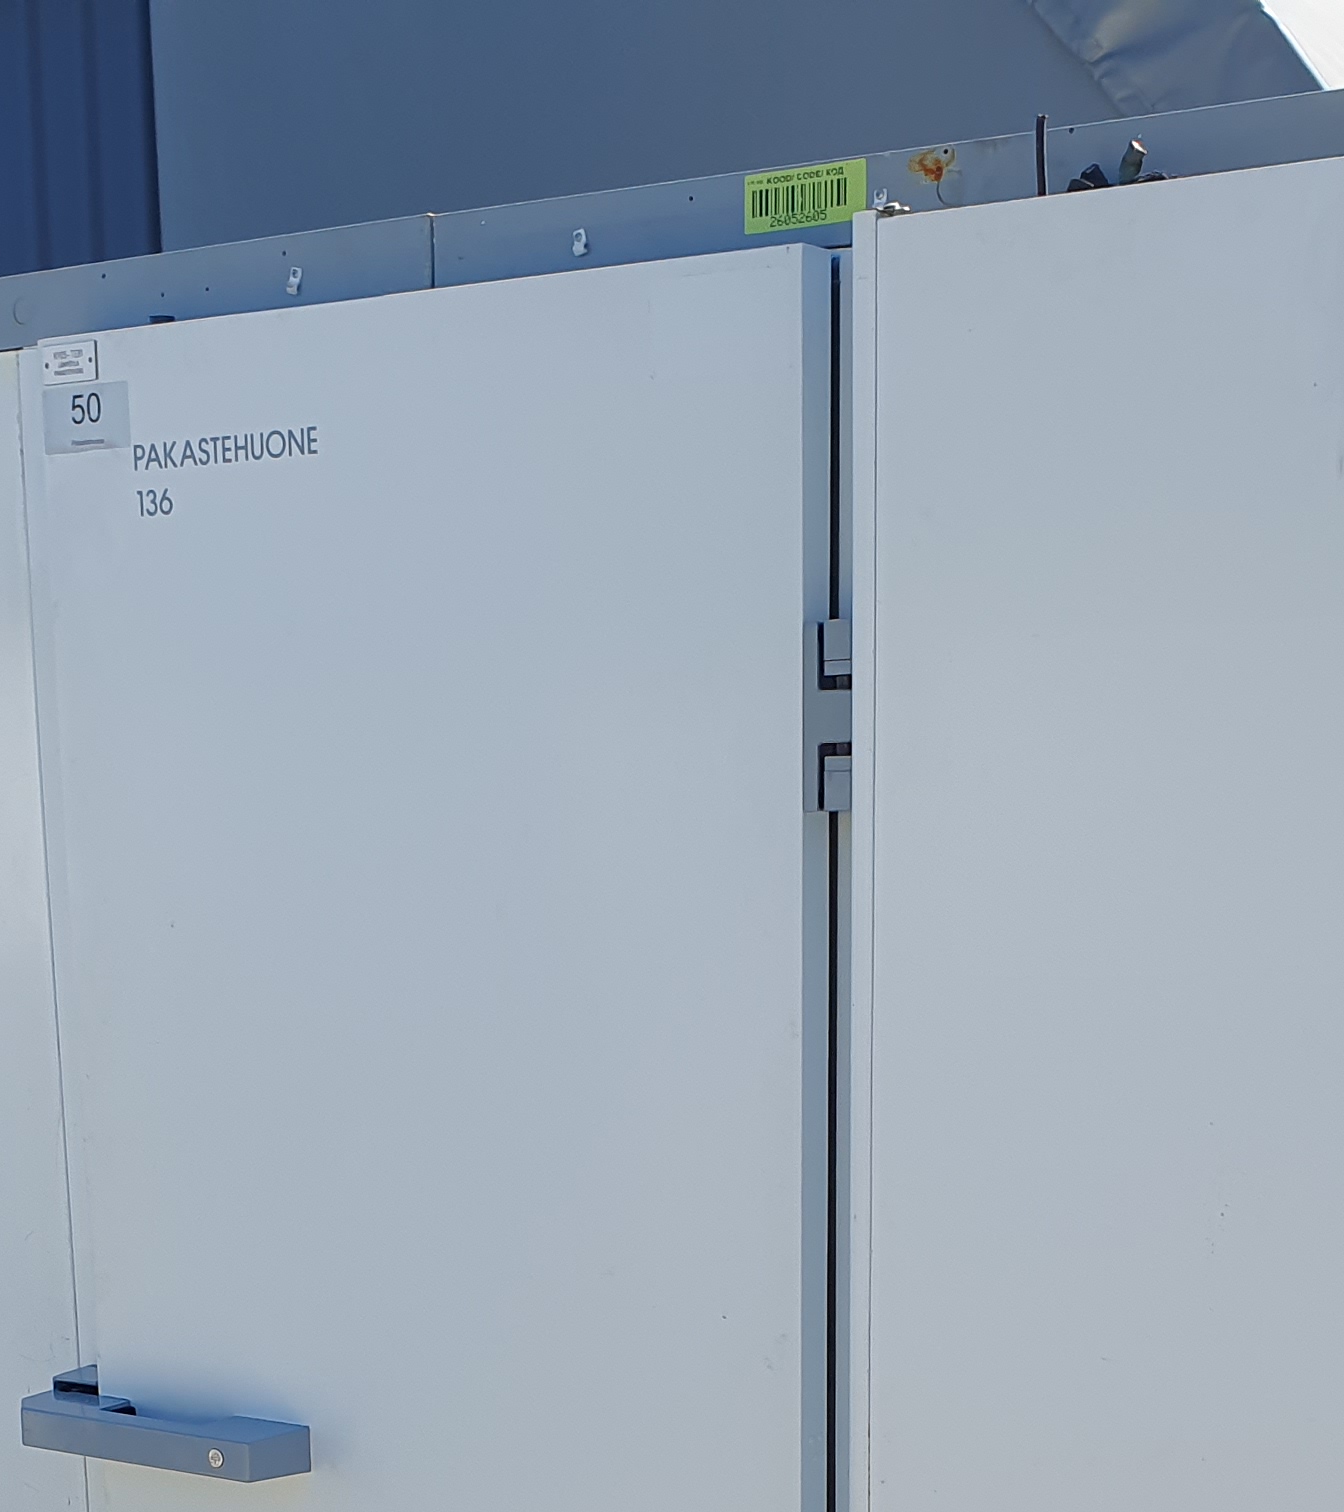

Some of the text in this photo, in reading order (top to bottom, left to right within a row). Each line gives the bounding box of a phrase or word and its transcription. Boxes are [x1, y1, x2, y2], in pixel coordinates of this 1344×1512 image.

[71, 392, 101, 425] 50
[133, 426, 319, 471] PAKASTEHUONE
[136, 488, 173, 517] 136
